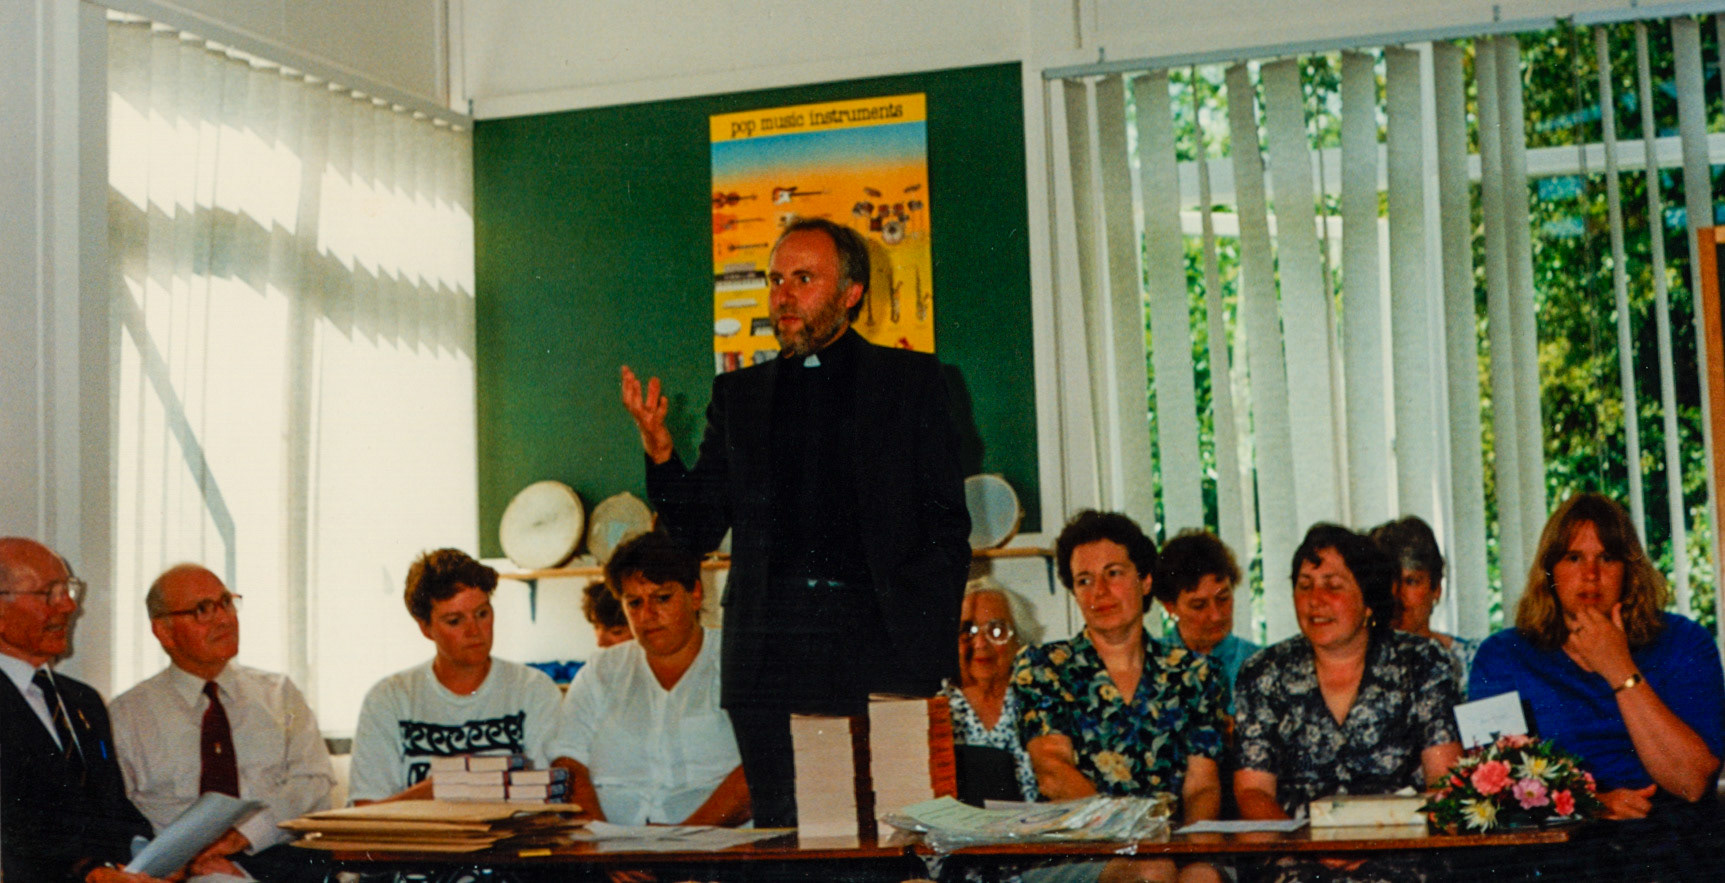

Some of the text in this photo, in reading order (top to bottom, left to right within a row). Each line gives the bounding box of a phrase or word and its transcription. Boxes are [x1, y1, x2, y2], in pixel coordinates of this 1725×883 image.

[731, 103, 903, 138] pop music instruments
